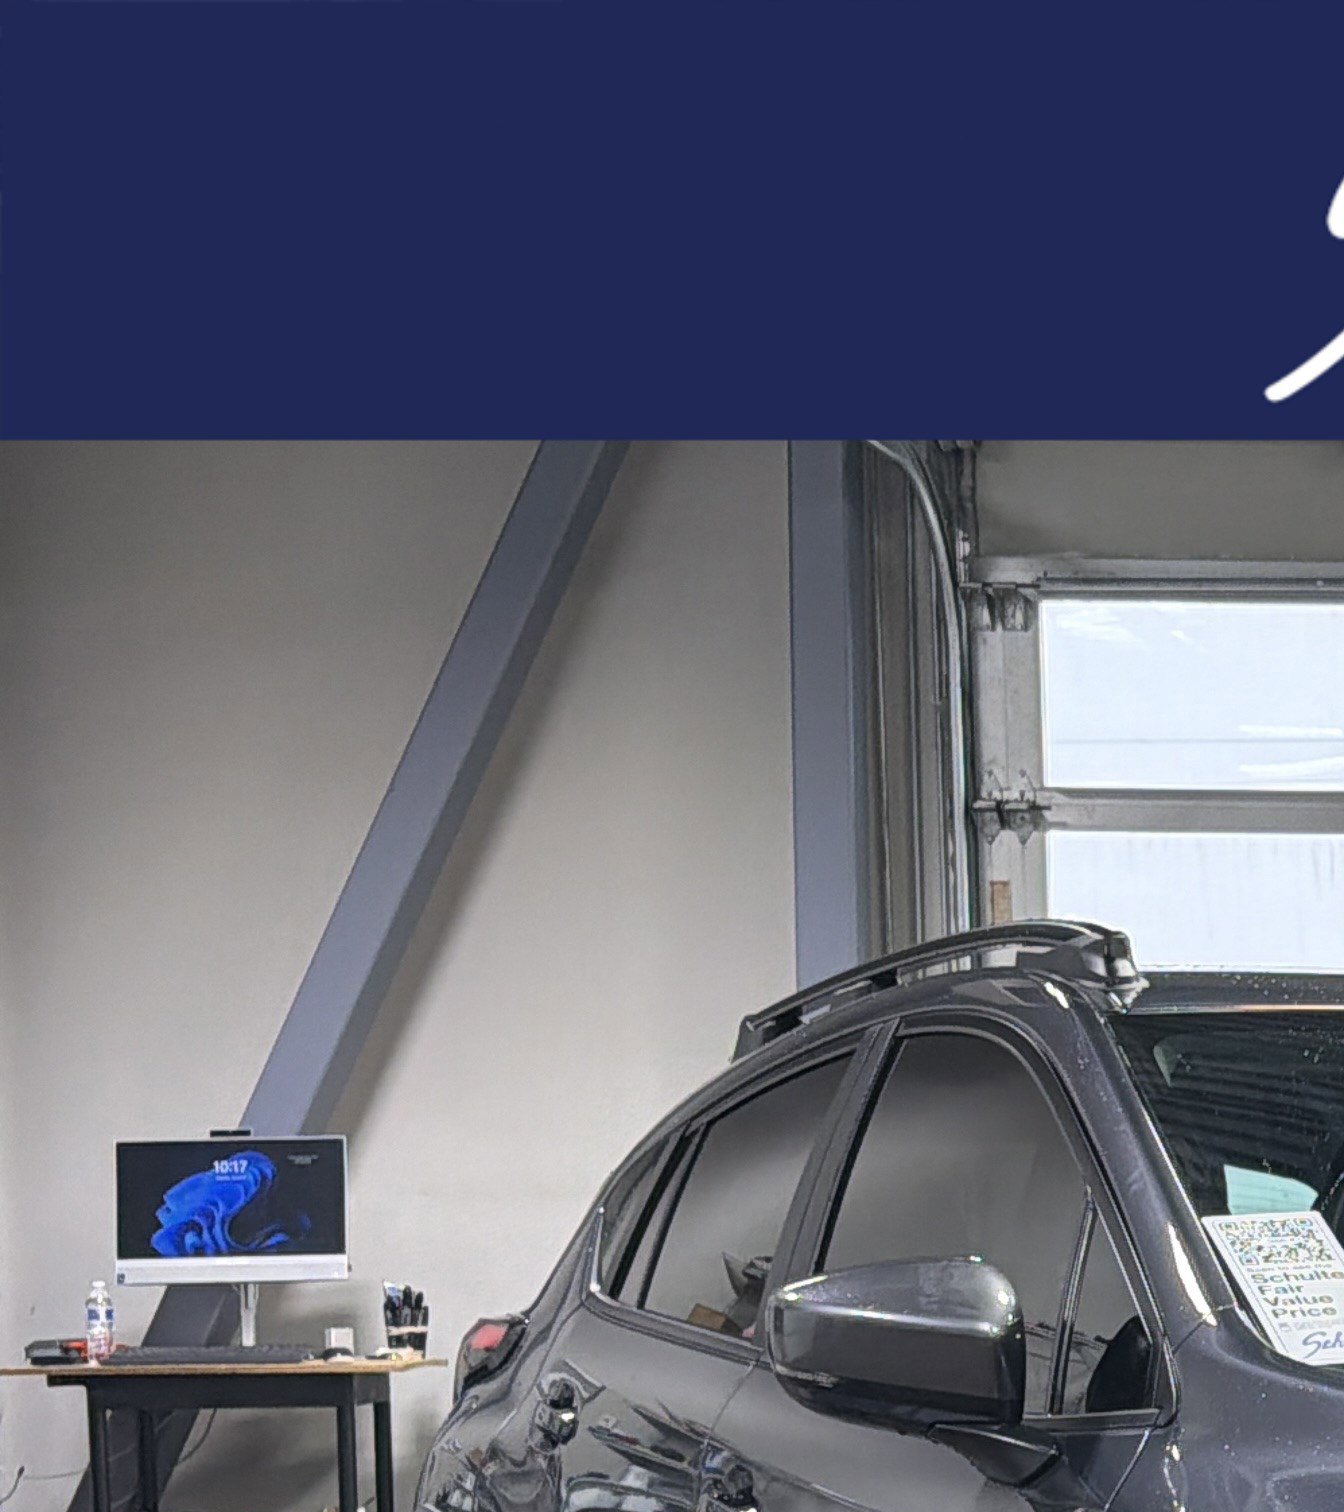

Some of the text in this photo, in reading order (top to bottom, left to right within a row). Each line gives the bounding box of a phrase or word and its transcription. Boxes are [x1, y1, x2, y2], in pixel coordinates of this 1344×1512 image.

[213, 1159, 248, 1174] 10:17
[1257, 1284, 1305, 1296] Fair
[1262, 1294, 1335, 1307] Value
[1271, 1306, 1338, 1319] Price
